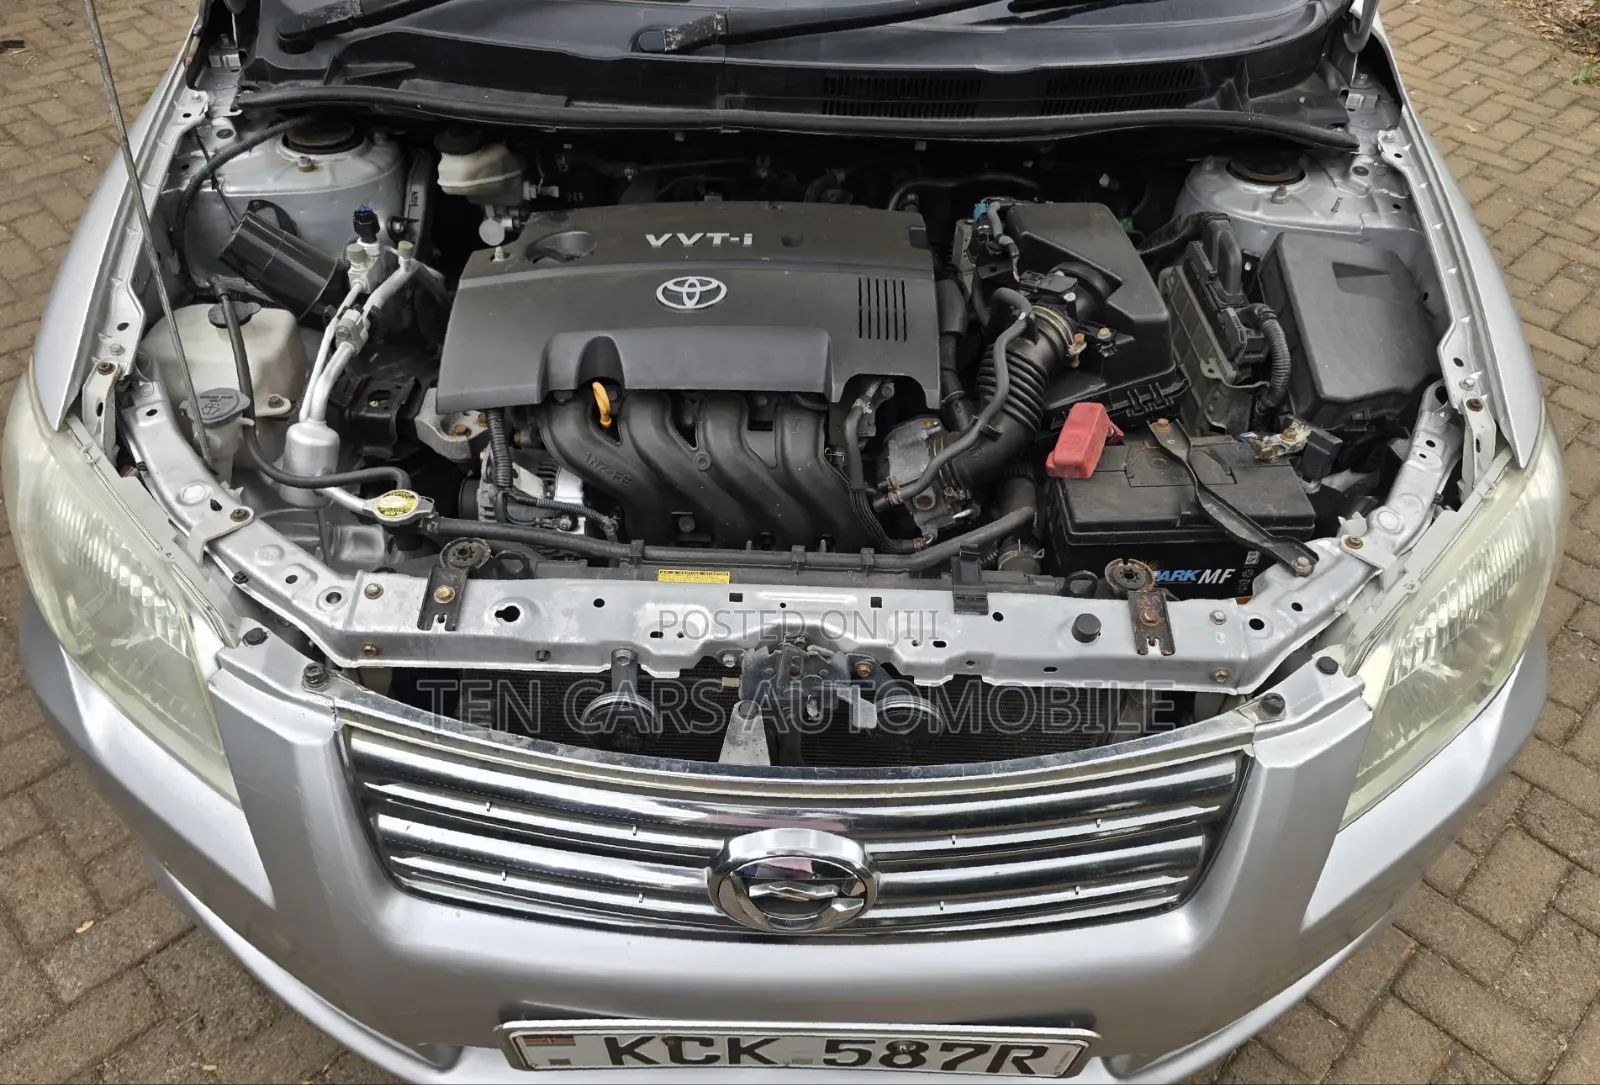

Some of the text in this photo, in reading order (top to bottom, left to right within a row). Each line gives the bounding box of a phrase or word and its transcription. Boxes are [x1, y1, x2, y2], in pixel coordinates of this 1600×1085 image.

[1197, 568, 1236, 585] MF
[603, 1035, 781, 1067] KCK
[822, 1038, 1050, 1075] 587R
